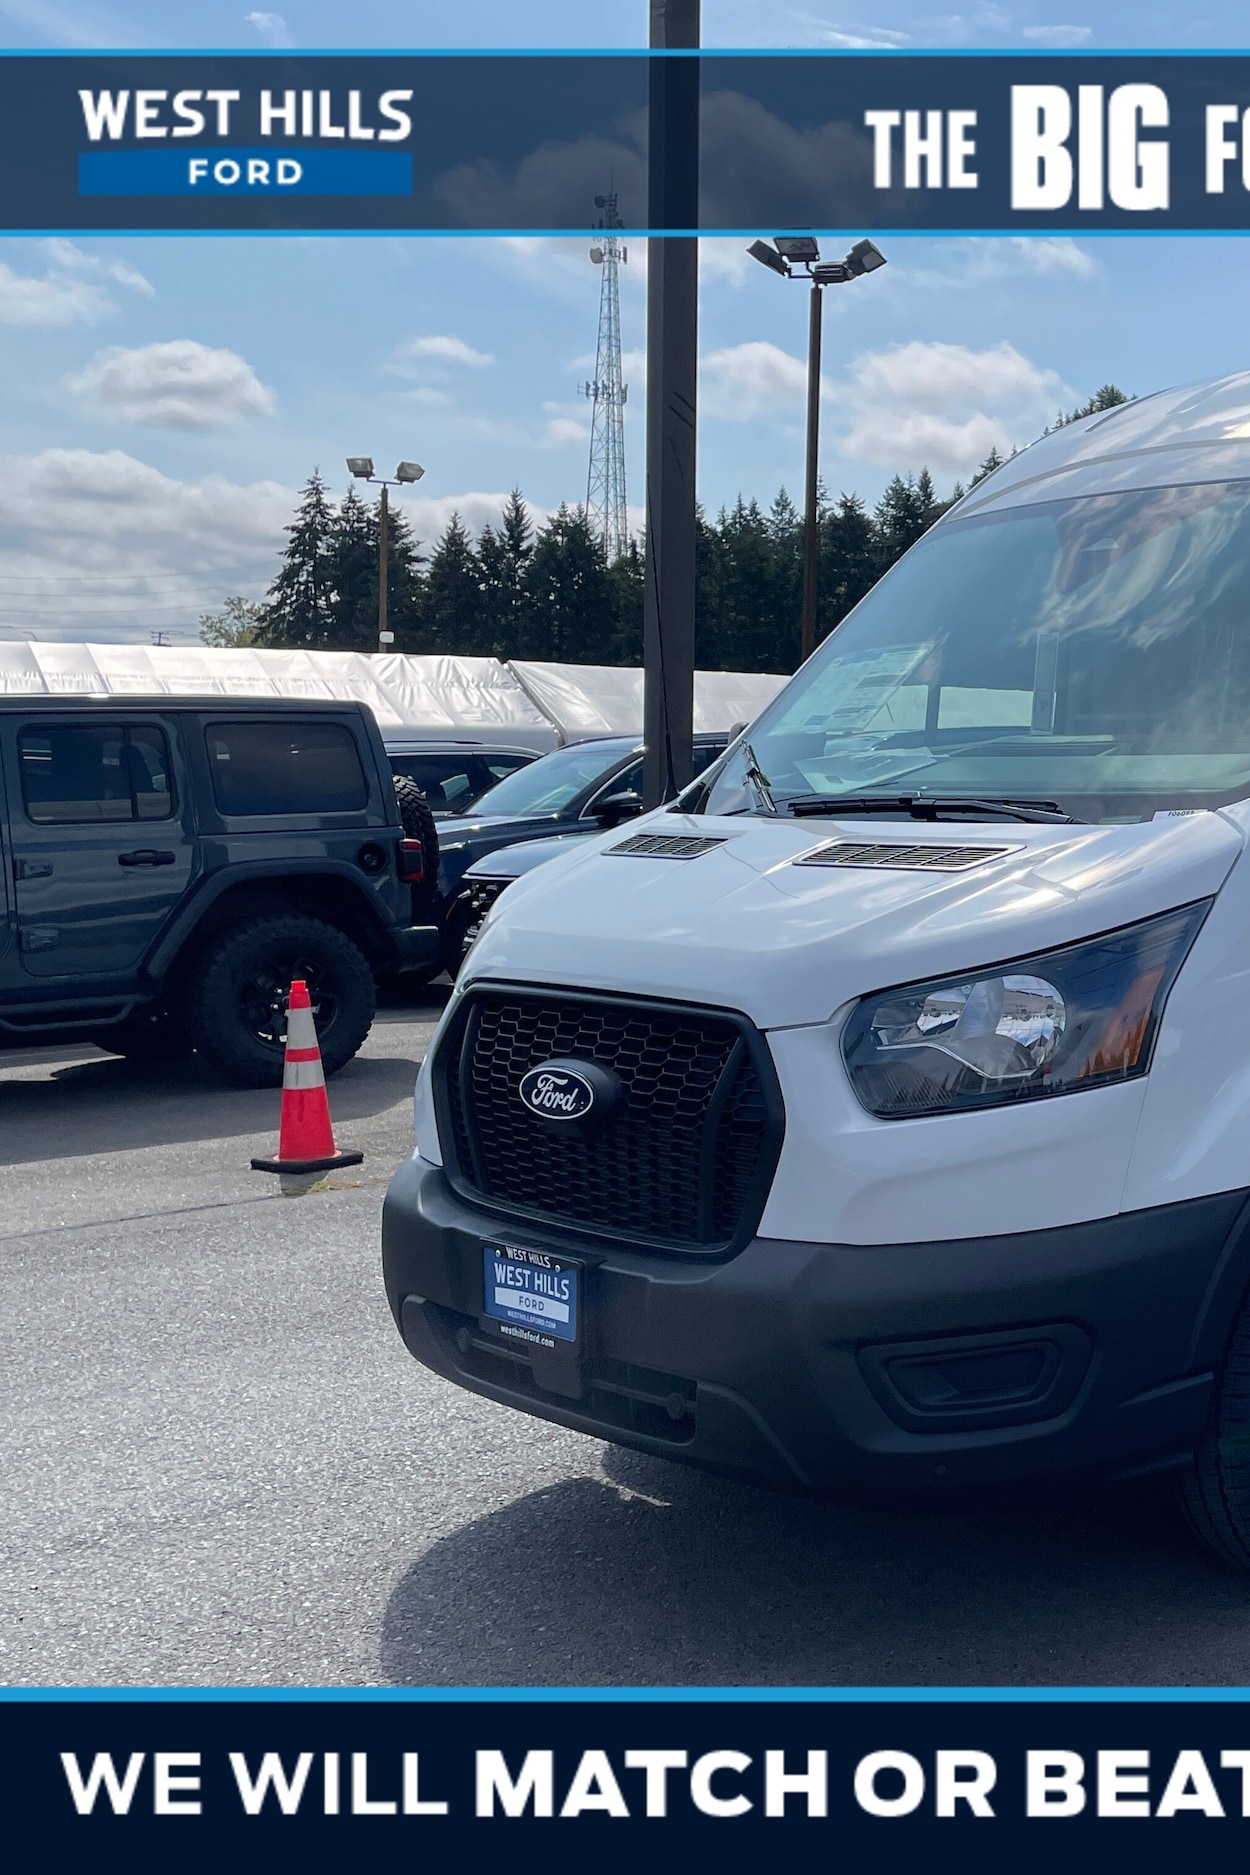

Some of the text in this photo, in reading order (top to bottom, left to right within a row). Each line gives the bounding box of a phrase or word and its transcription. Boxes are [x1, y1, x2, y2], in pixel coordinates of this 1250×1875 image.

[531, 1073, 579, 1112] Ford
[505, 1246, 551, 1269] WEST HILLS
[493, 1262, 570, 1301] WEST HILLS
[518, 1295, 545, 1312] FORD
[500, 1325, 555, 1348] westhillsford.com
